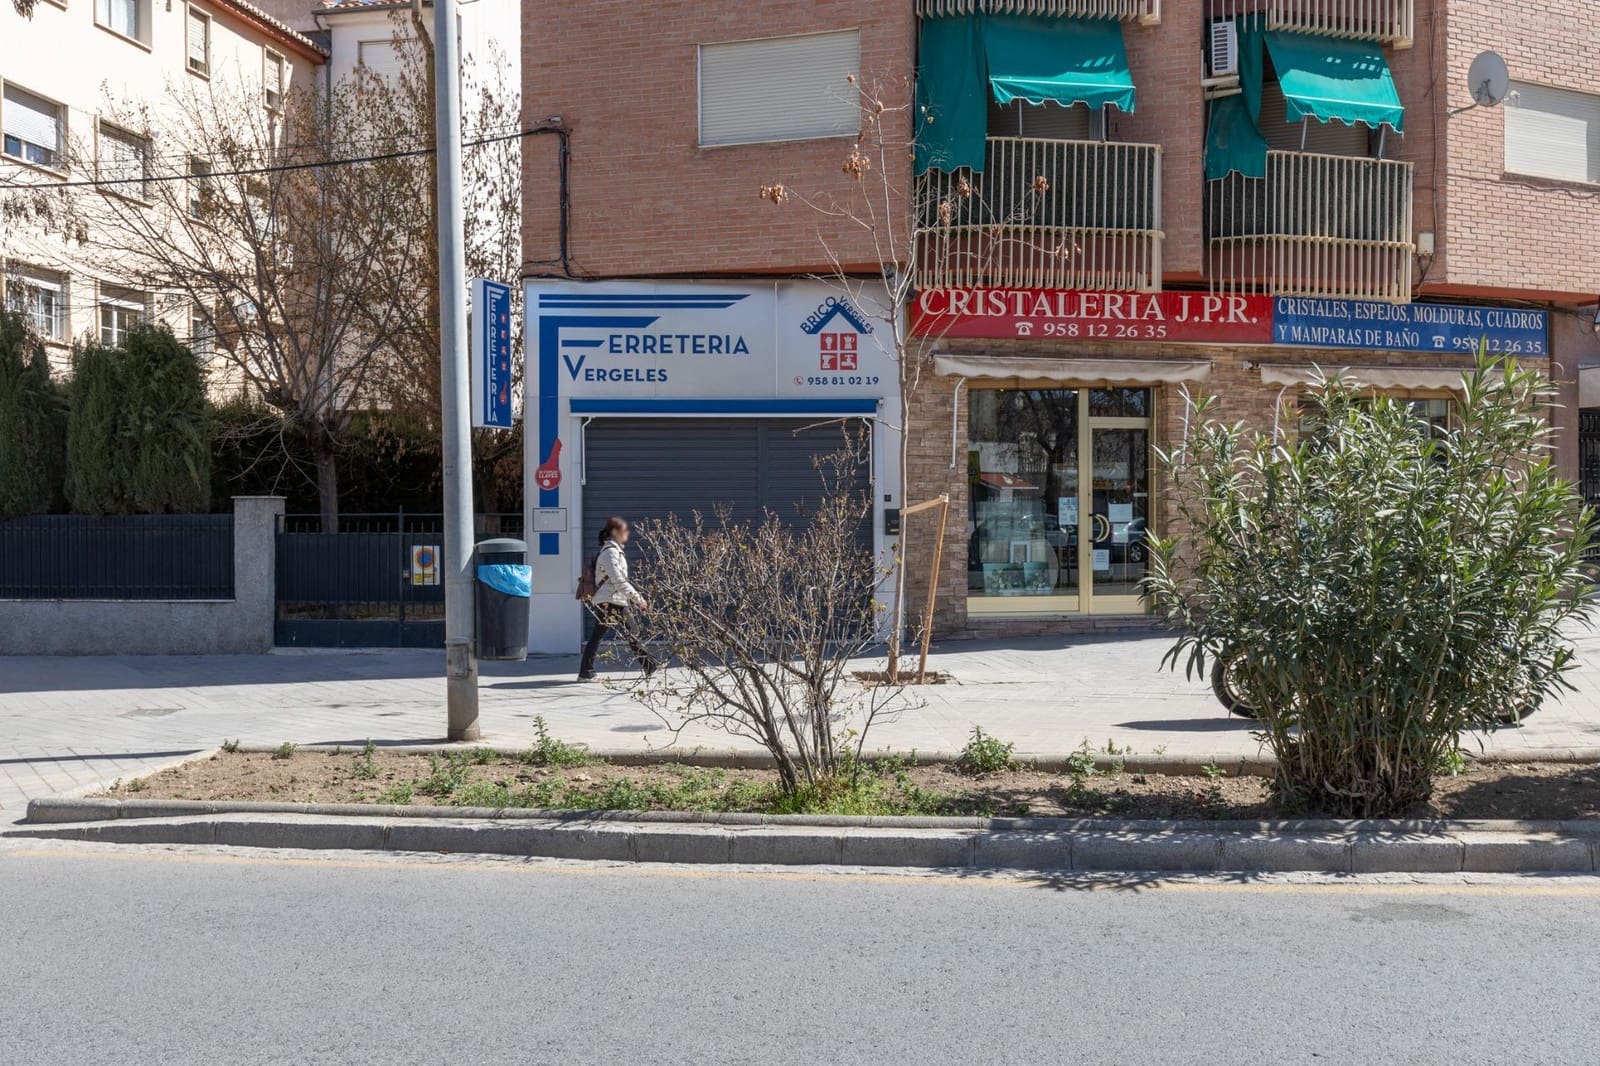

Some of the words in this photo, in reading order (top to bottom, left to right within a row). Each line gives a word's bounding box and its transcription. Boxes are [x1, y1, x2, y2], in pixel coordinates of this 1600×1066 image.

[800, 296, 837, 333] BRICO
[839, 296, 874, 334] VERGELES
[920, 288, 1166, 321] CRISTALERIA
[1175, 295, 1258, 324] J.P.R.
[1278, 297, 1351, 320] CRISTALES,
[1355, 302, 1410, 324] ESPEJOS,
[1414, 306, 1484, 328] MOLDURAS,
[1487, 311, 1543, 330] CUADROS
[1043, 323, 1079, 336] 958
[1088, 323, 1108, 337] 12
[1115, 324, 1138, 338] 26
[1145, 325, 1167, 338] 35
[1279, 324, 1288, 340] Y
[1291, 326, 1361, 345] MAMPARAS
[1365, 330, 1382, 346] DE
[1386, 328, 1420, 347] BAÑO
[1452, 337, 1479, 351] 958
[1485, 338, 1500, 351] 12
[1504, 339, 1522, 352] 26
[1526, 340, 1542, 353] 35
[563, 354, 668, 381] VERGELES
[807, 377, 828, 385] 958
[832, 377, 845, 385] 81
[848, 377, 864, 385] 02
[865, 377, 879, 385] 19
